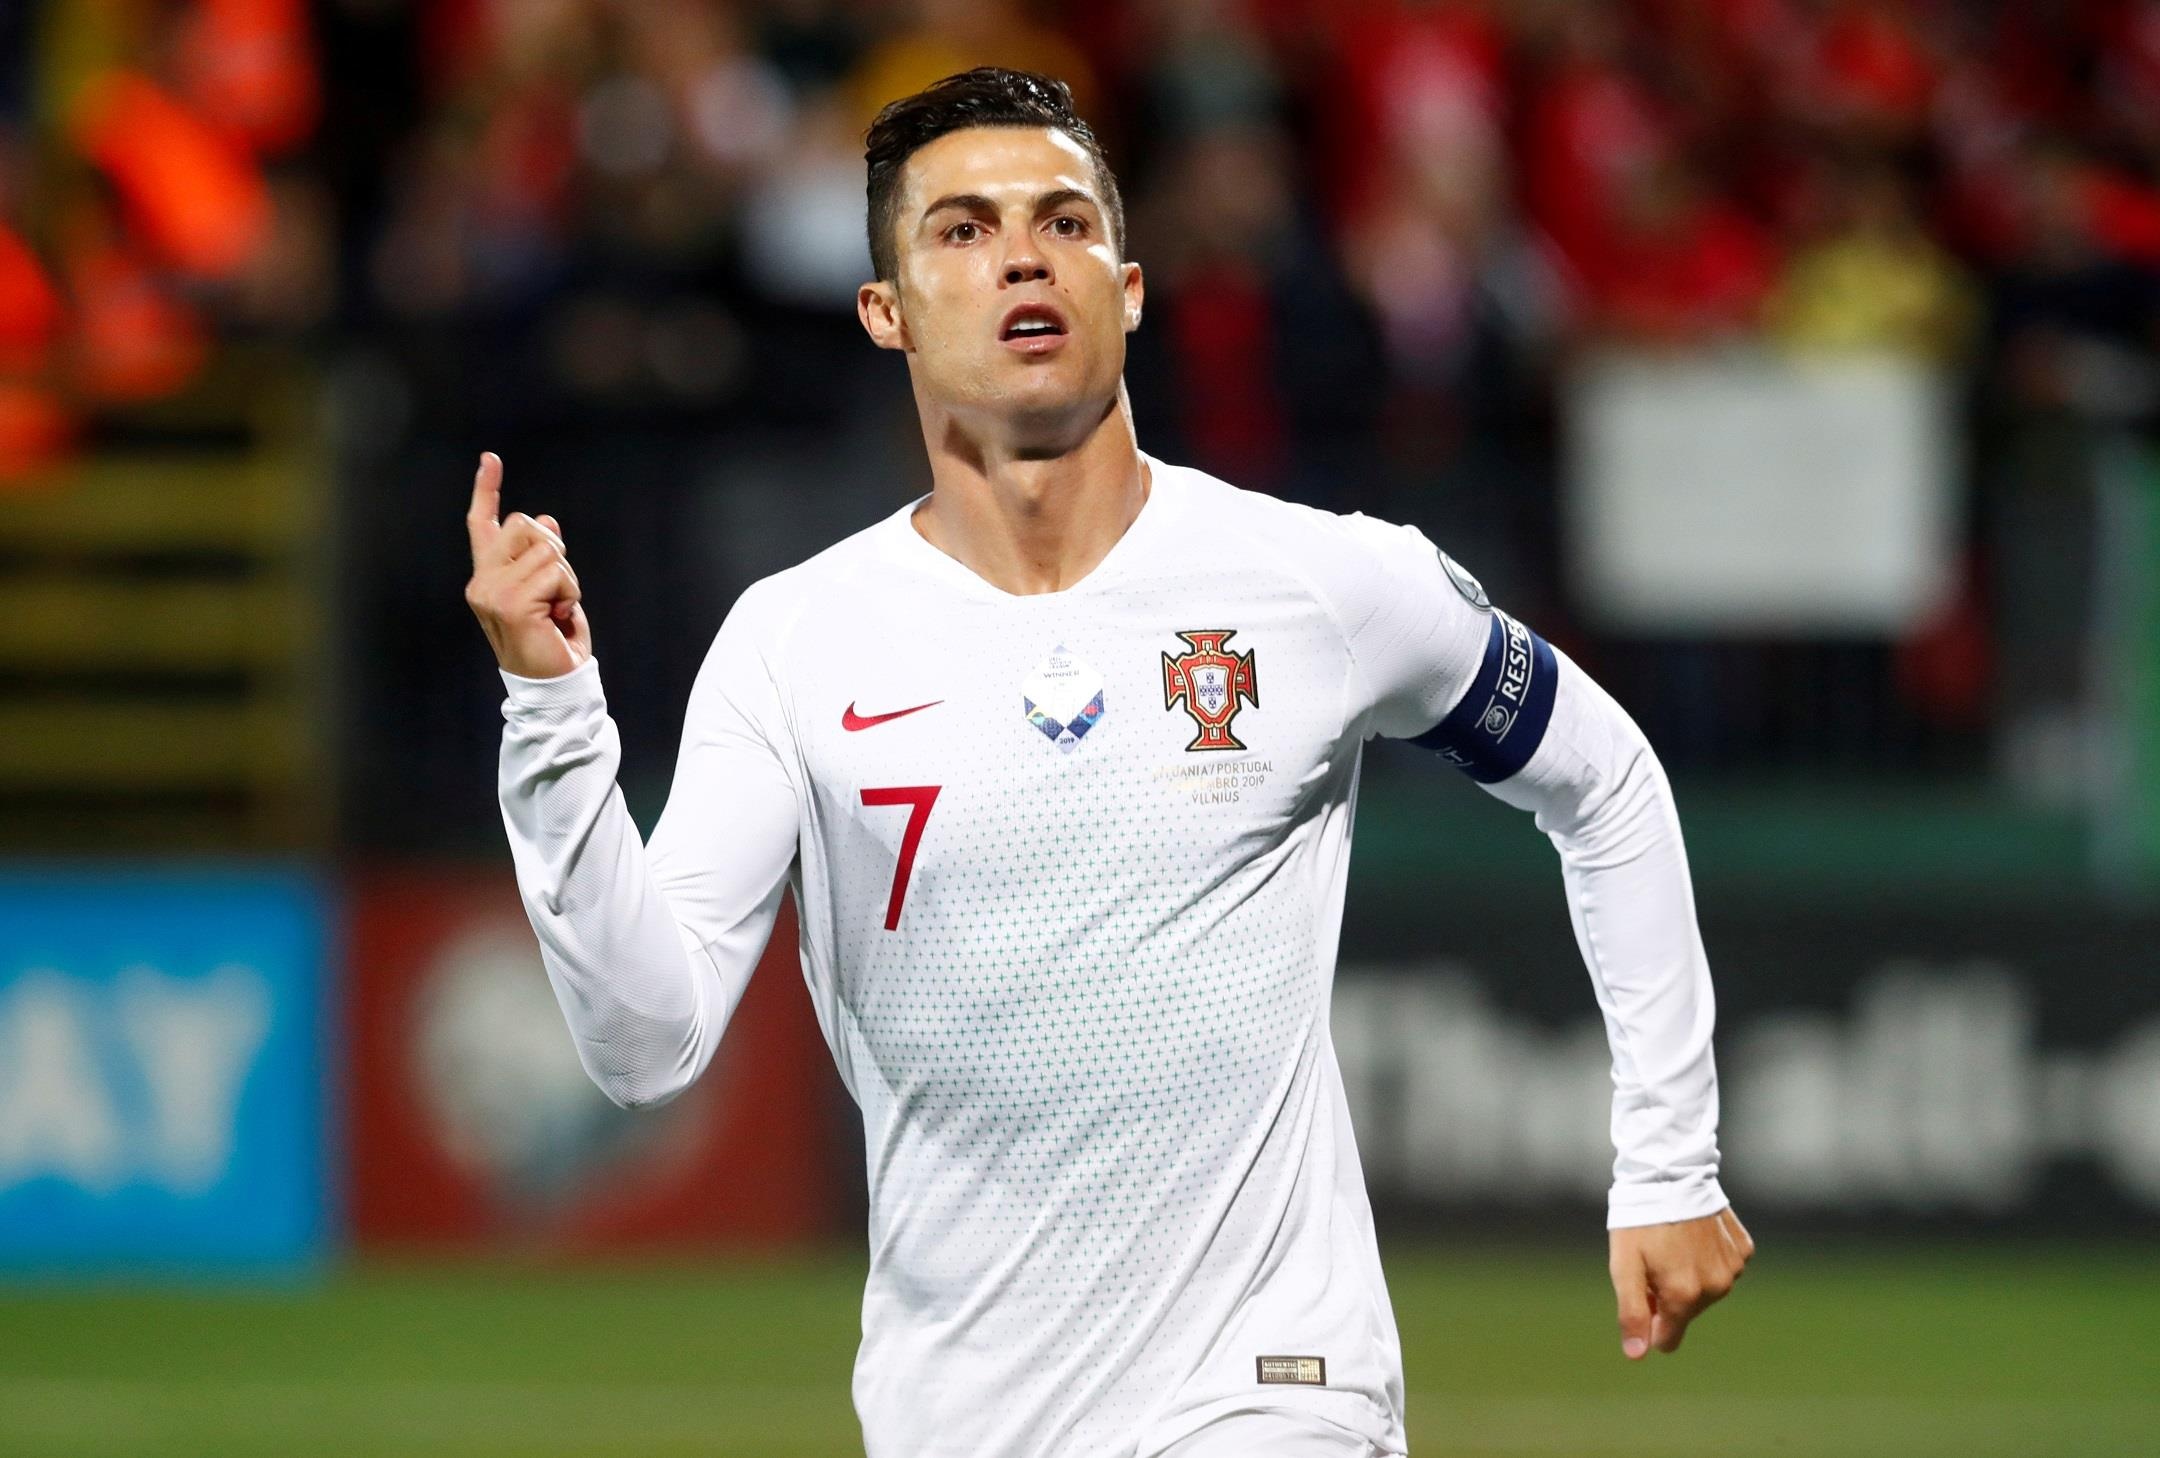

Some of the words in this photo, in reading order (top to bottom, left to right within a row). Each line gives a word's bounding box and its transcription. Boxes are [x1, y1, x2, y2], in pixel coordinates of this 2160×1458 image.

[1501, 618, 1528, 701] RESPE
[1059, 736, 1076, 745] 2019
[1242, 774, 1265, 787] 2019
[1192, 791, 1240, 806] VILNIUS
[859, 785, 942, 931] 7
